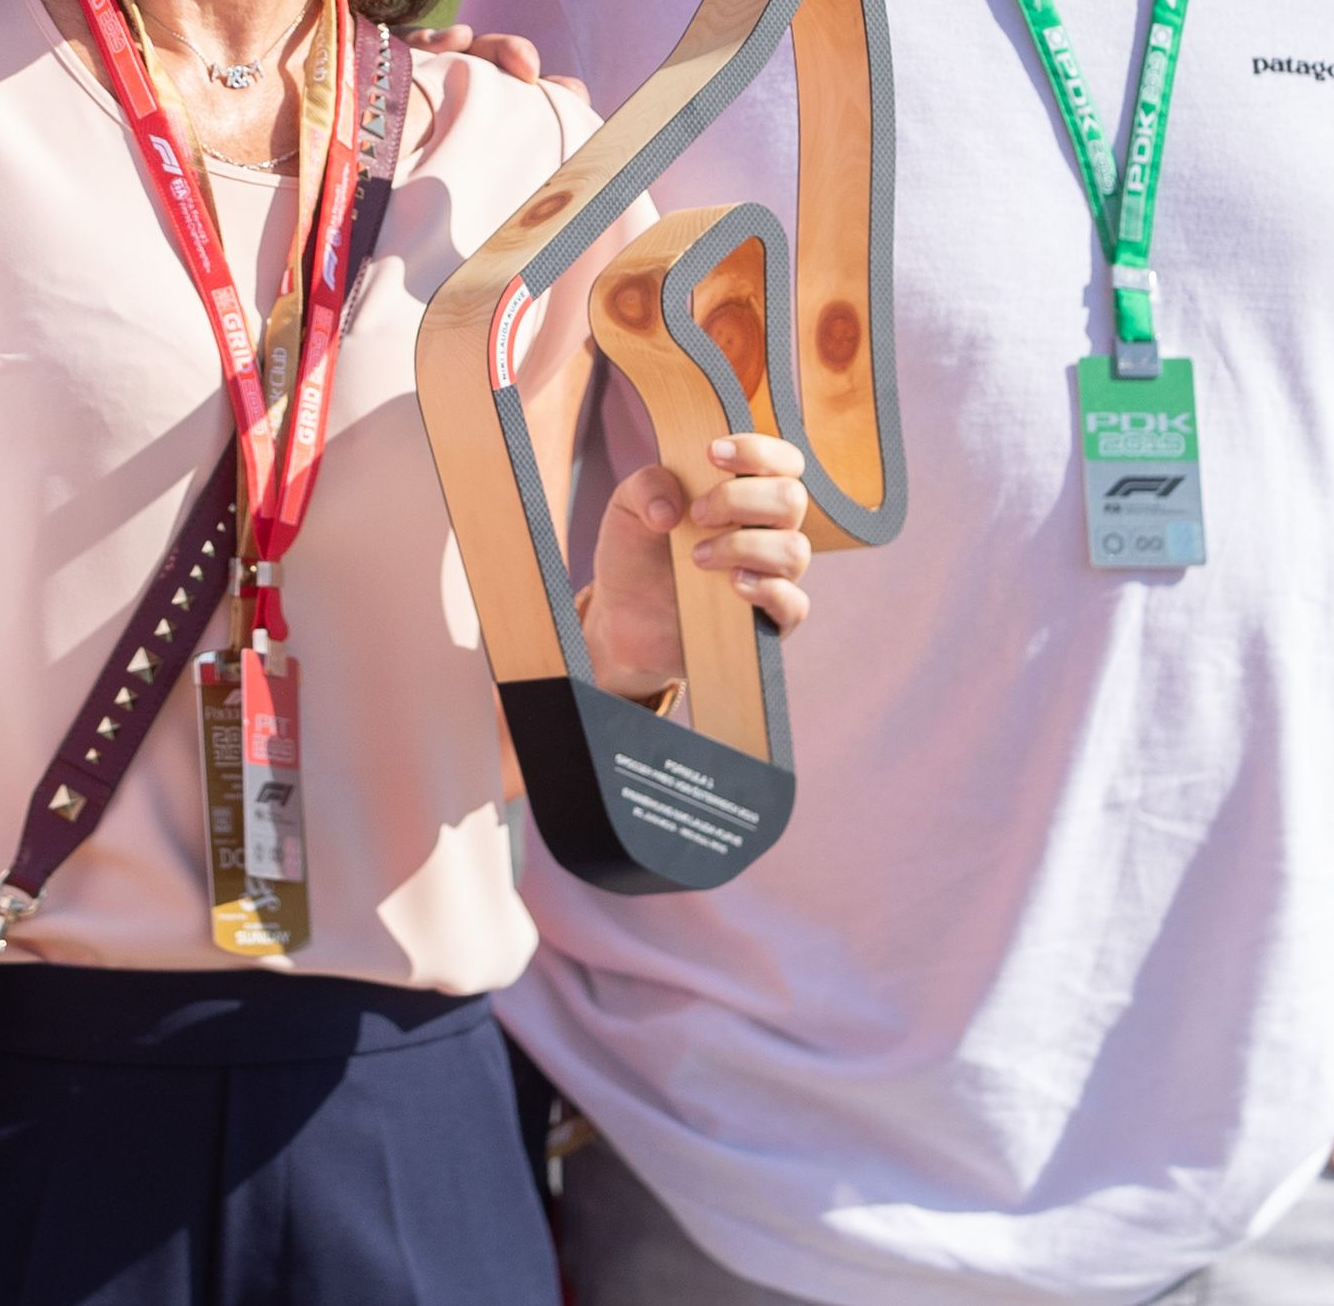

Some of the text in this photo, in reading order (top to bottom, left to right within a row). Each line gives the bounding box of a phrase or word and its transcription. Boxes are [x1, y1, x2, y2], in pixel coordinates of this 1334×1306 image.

[1057, 50, 1101, 133] PDK
[1127, 103, 1158, 192] PDK
[222, 312, 255, 375] GRID
[298, 386, 321, 445] GRID
[1085, 411, 1193, 433] PDK
[1104, 474, 1187, 497] F1
